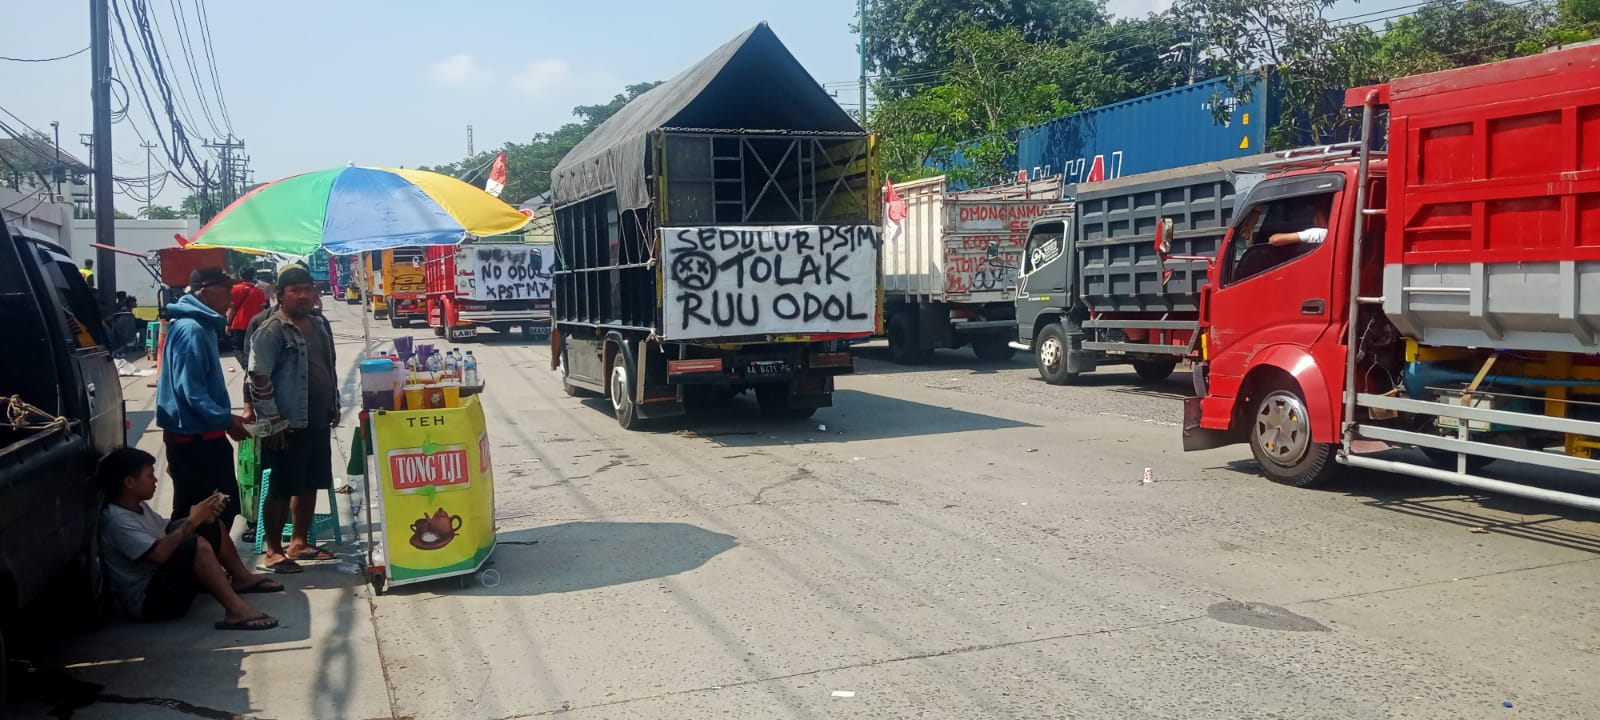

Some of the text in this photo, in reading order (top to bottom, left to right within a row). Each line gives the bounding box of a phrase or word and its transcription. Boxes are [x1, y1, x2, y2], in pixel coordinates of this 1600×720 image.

[670, 225, 882, 256] SEDULUR PSTM
[481, 262, 502, 283] NO
[717, 249, 850, 289] TOLAK
[676, 291, 868, 330] RUU ODOL
[406, 414, 446, 428] TEH
[395, 454, 437, 484] TONG
[438, 452, 463, 482] TJI
